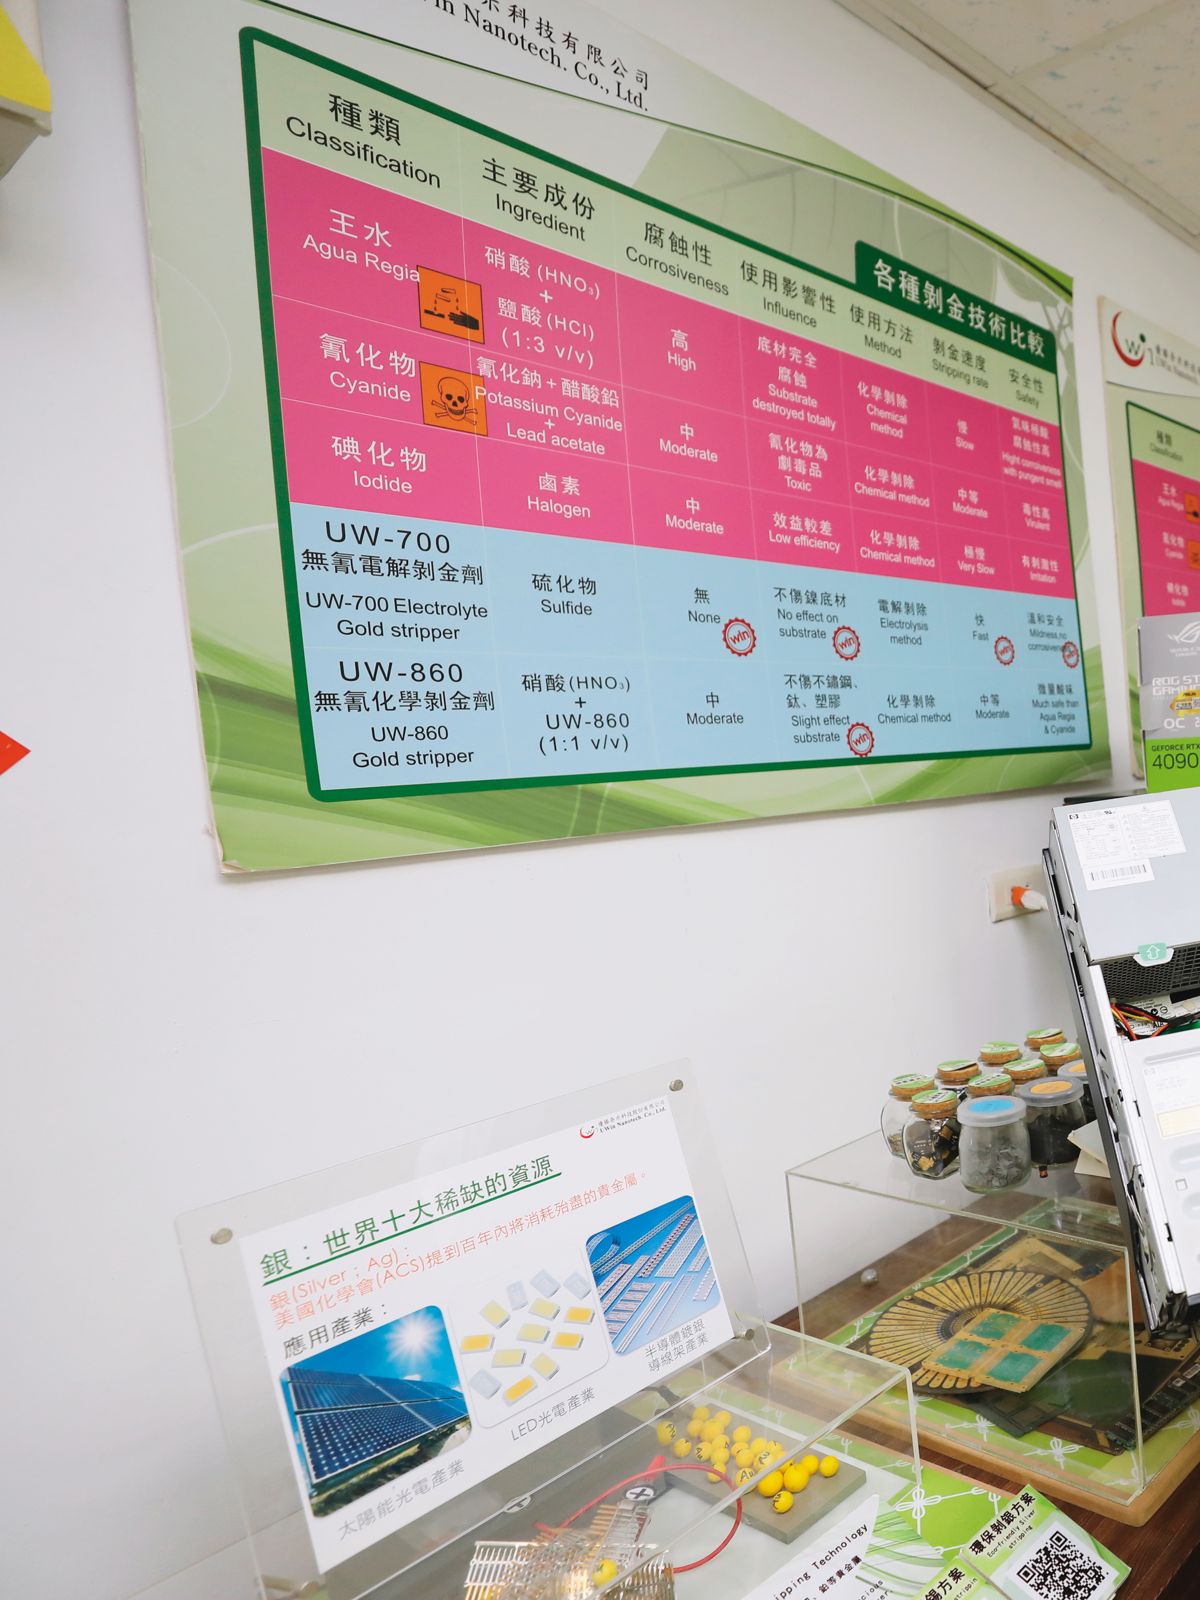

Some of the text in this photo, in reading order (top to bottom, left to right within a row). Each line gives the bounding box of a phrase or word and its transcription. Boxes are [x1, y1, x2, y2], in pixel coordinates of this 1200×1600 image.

[424, 0, 648, 111] in Nanotech. Co., Ltd.
[328, 92, 401, 146] 種類
[286, 116, 441, 188] Classification
[482, 157, 596, 220] 主要成份
[329, 208, 392, 247] 王水
[496, 193, 586, 241] Ingredient
[644, 221, 712, 267] 腐蝕性
[365, 251, 420, 283] Regia
[626, 246, 729, 295] Corrosiveness
[740, 259, 836, 314] 使用影響性
[763, 297, 817, 328] Influence
[872, 258, 1044, 358] 各種剝金技術比較
[849, 303, 913, 344] 使用方法
[671, 329, 688, 351] 高
[757, 336, 817, 368] 底材完全
[864, 334, 902, 358] Method
[319, 332, 416, 378] 氰化物
[667, 352, 696, 372] High
[778, 366, 807, 389] 腐蝕
[932, 358, 989, 389] Stripping rate
[1008, 368, 1044, 393] 安全性
[330, 371, 411, 403] Cyanide
[768, 383, 817, 408] Substrate
[475, 386, 623, 433] Potassium Cyanide
[752, 397, 836, 431] destroyed totally
[866, 403, 907, 425] Chemical
[506, 422, 605, 455] Lead acetate
[680, 423, 694, 441] 中
[870, 422, 903, 439] method
[331, 436, 427, 473] 碘化物
[659, 439, 718, 462] Moderate
[353, 470, 413, 494] Iodide
[538, 472, 582, 496] 鹵素
[784, 475, 812, 492] Toxic
[686, 496, 700, 514] 中
[854, 482, 930, 508] Chemical method
[528, 496, 590, 519] Halogen
[953, 502, 988, 518] Moderate
[665, 514, 724, 534] Moderate
[772, 511, 833, 537] 效益較差
[325, 520, 451, 554] UW-700
[768, 530, 840, 554] Low efficiency
[860, 546, 935, 568] Chemical method
[977, 562, 995, 575] Slow
[531, 572, 597, 595] 硫化物
[694, 587, 710, 604] 無
[305, 592, 488, 619] UW-700 Electrolyte
[541, 599, 592, 616] Sulfide
[688, 610, 720, 624] None
[777, 609, 838, 623] No effect on
[337, 619, 460, 641] Gold stripper
[779, 627, 826, 639] substrate
[880, 618, 928, 631] Electrolysis
[973, 631, 989, 641] Fast
[890, 634, 922, 646] method
[339, 660, 463, 682] UW-860
[706, 691, 719, 708] 中
[546, 713, 630, 729] UW-860
[687, 712, 744, 725] Moderate
[791, 714, 850, 728] Slight effect
[877, 712, 951, 724] Chemical method
[975, 710, 1009, 719] Moderate
[1163, 718, 1185, 729] OC
[371, 724, 449, 742] UW-860
[590, 733, 629, 753] v/v)
[793, 732, 840, 744] substrate
[352, 749, 474, 768] Gold stripper
[1152, 752, 1199, 769] 4090
[648, 1332, 710, 1373] 導線架產業
[510, 1386, 596, 1441] LED光電產業
[338, 1458, 465, 1540] 太陽能光電產業
[969, 1492, 1036, 1556] 環保剝銀方案
[987, 1510, 1035, 1558] Eco-friendly Silver
[812, 1523, 868, 1570] Technology
[1008, 1525, 1033, 1550] stripping
